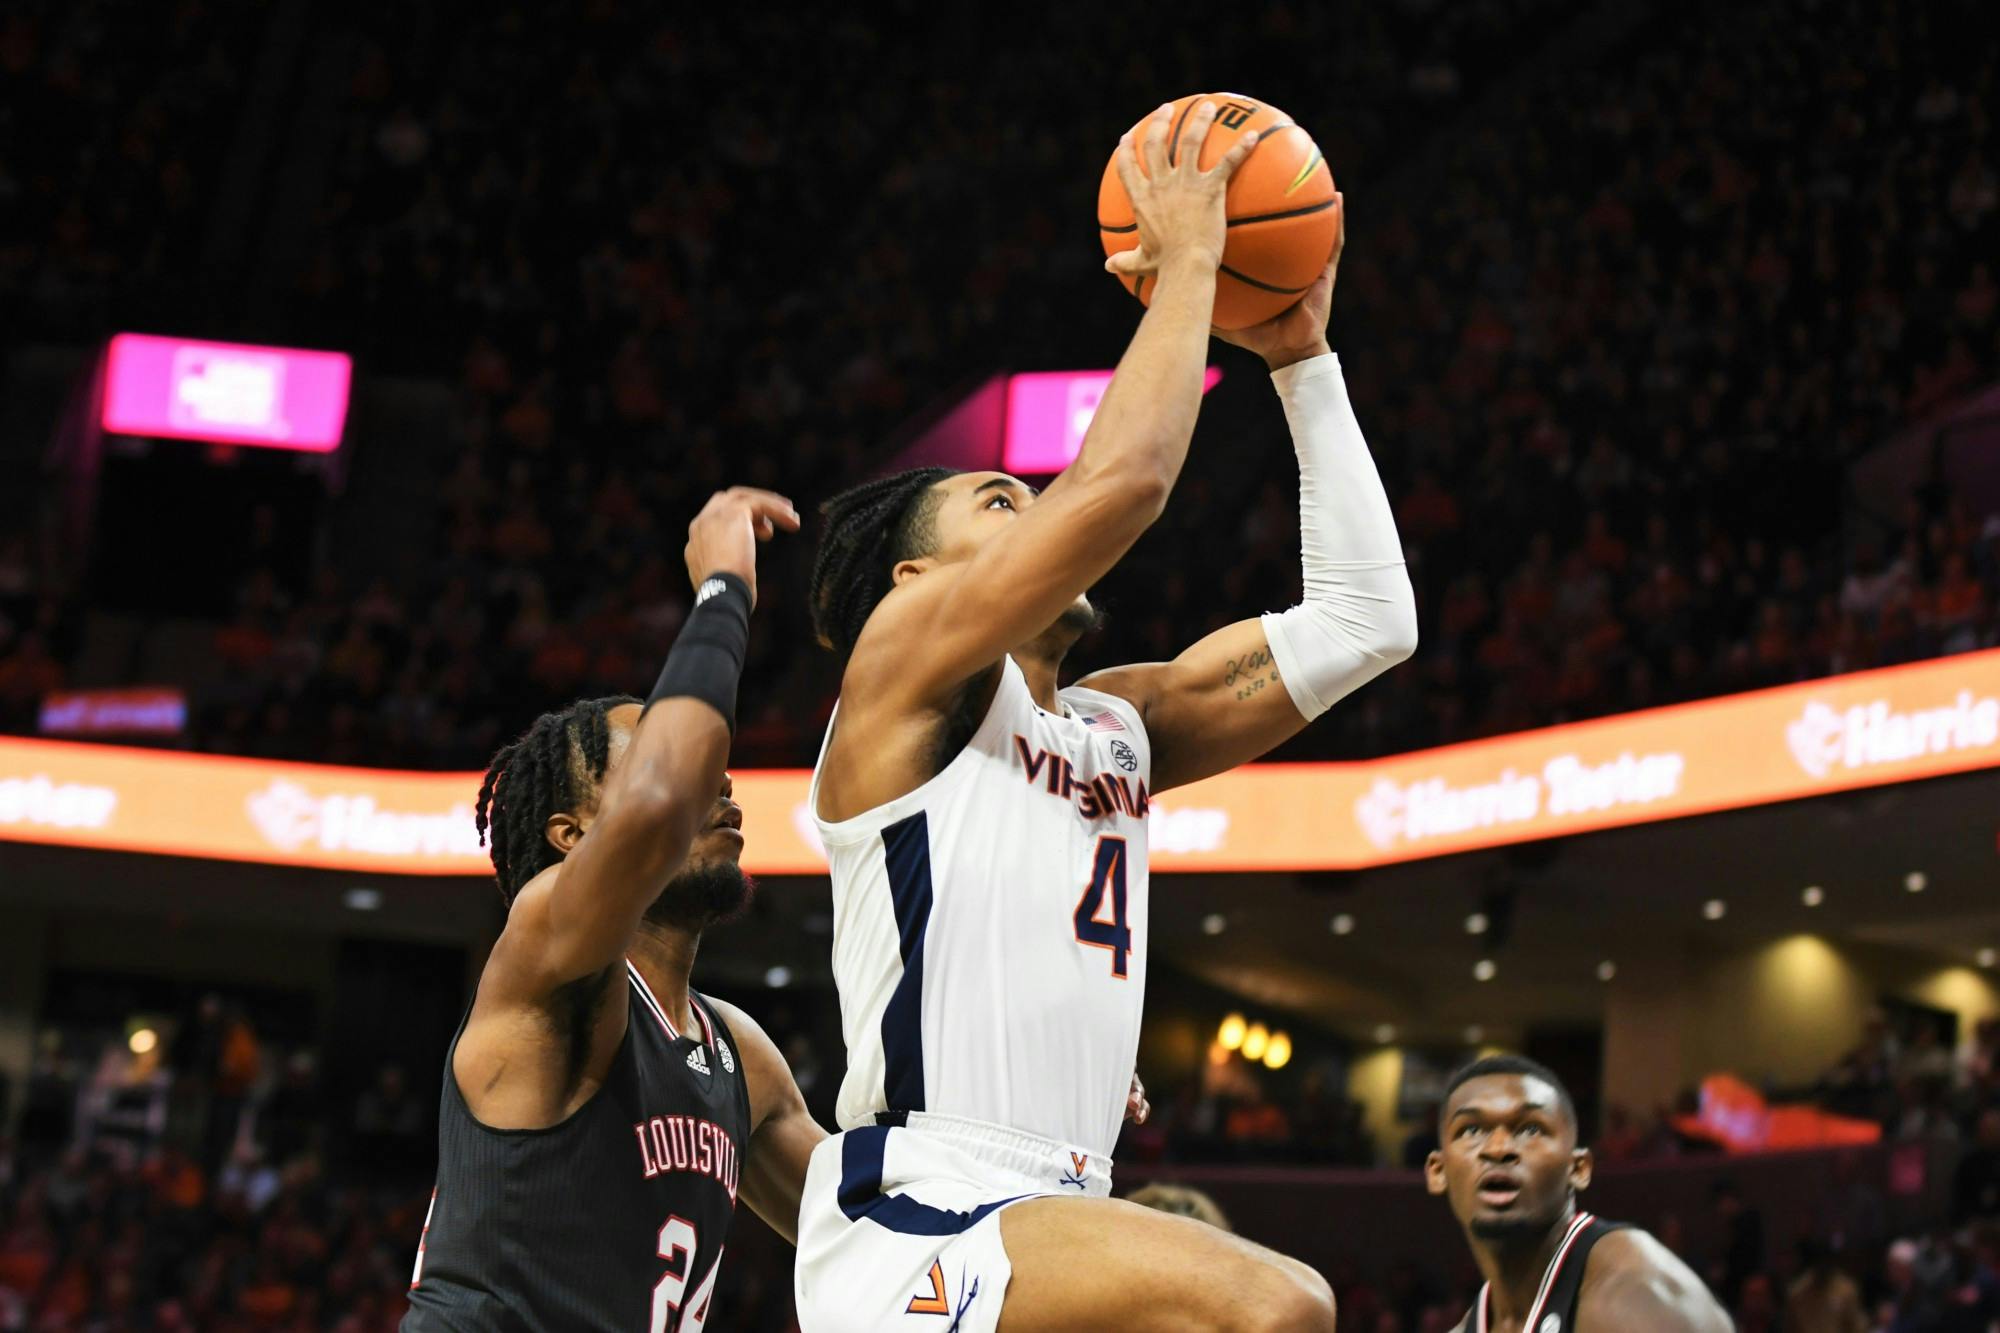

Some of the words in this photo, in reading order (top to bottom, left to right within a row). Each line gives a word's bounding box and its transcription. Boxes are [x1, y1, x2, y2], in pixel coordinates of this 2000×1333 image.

[1845, 689, 2000, 768] Harris
[1013, 733, 1150, 819] VIRGINIA
[1073, 834, 1132, 980] 4
[634, 1115, 740, 1204] LOUISVIL
[648, 1213, 725, 1333] 24
